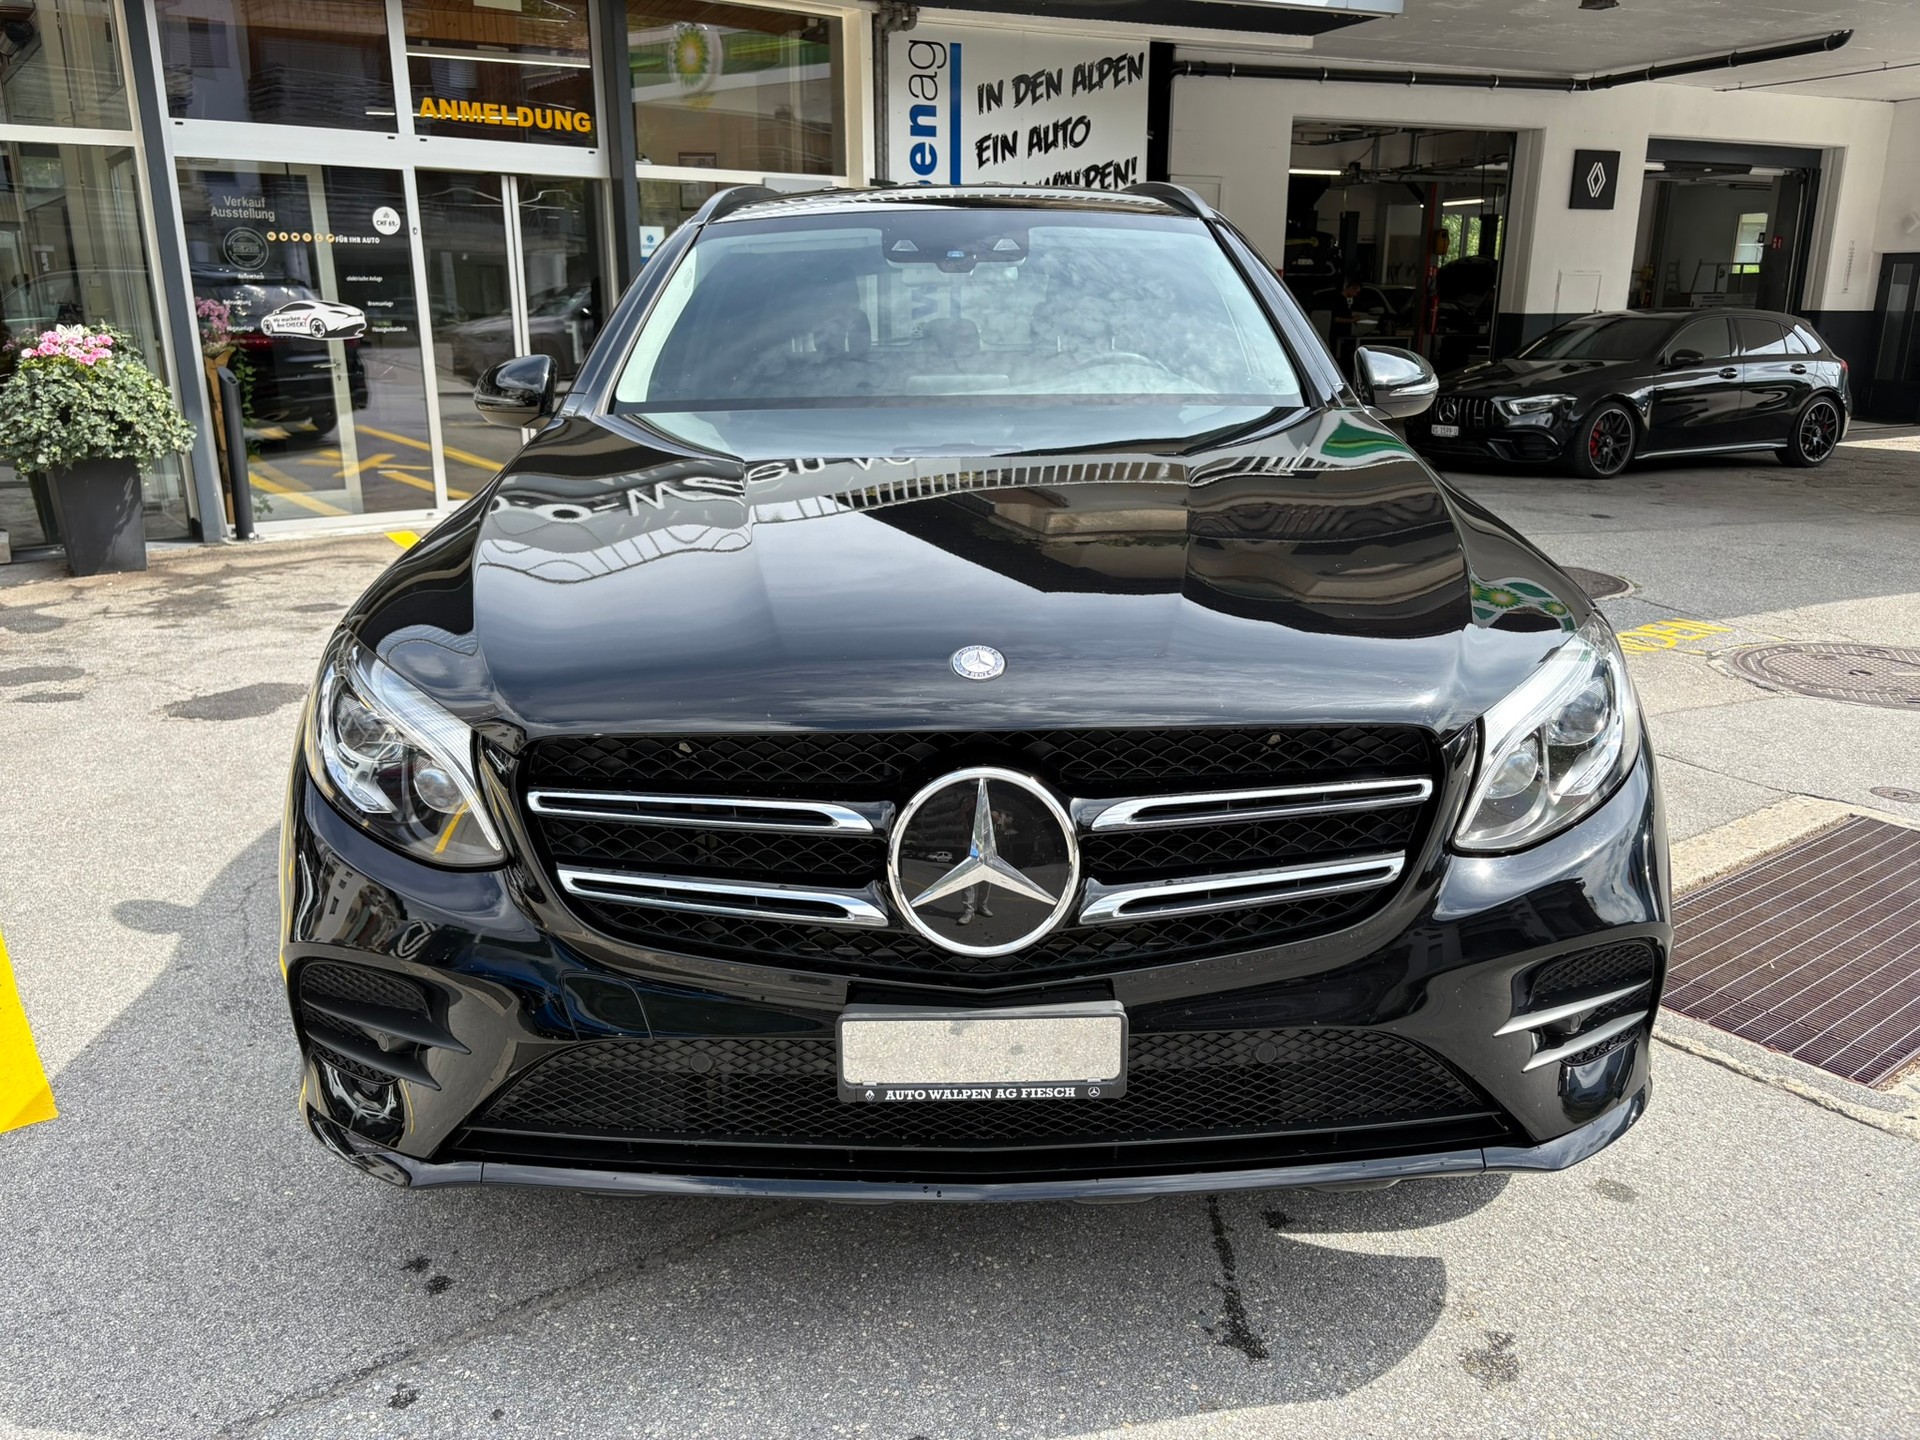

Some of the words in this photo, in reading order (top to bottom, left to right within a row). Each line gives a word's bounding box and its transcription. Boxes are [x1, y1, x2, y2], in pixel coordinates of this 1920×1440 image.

[977, 79, 1004, 115] IN
[1012, 67, 1063, 109] DEN
[1072, 52, 1144, 97] ALPEN
[420, 96, 592, 133] ANMELDUNG
[908, 39, 947, 184] enag
[975, 130, 1018, 170] EIN
[1027, 115, 1091, 159] AUTO
[210, 205, 275, 222] Ausstellung
[223, 195, 265, 208] Verkauf
[335, 235, 348, 243] FÜR
[885, 1089, 926, 1100] AUTO
[928, 1089, 993, 1100] WALPEN
[995, 1088, 1018, 1099] AG
[1020, 1087, 1076, 1098] FIESCH
